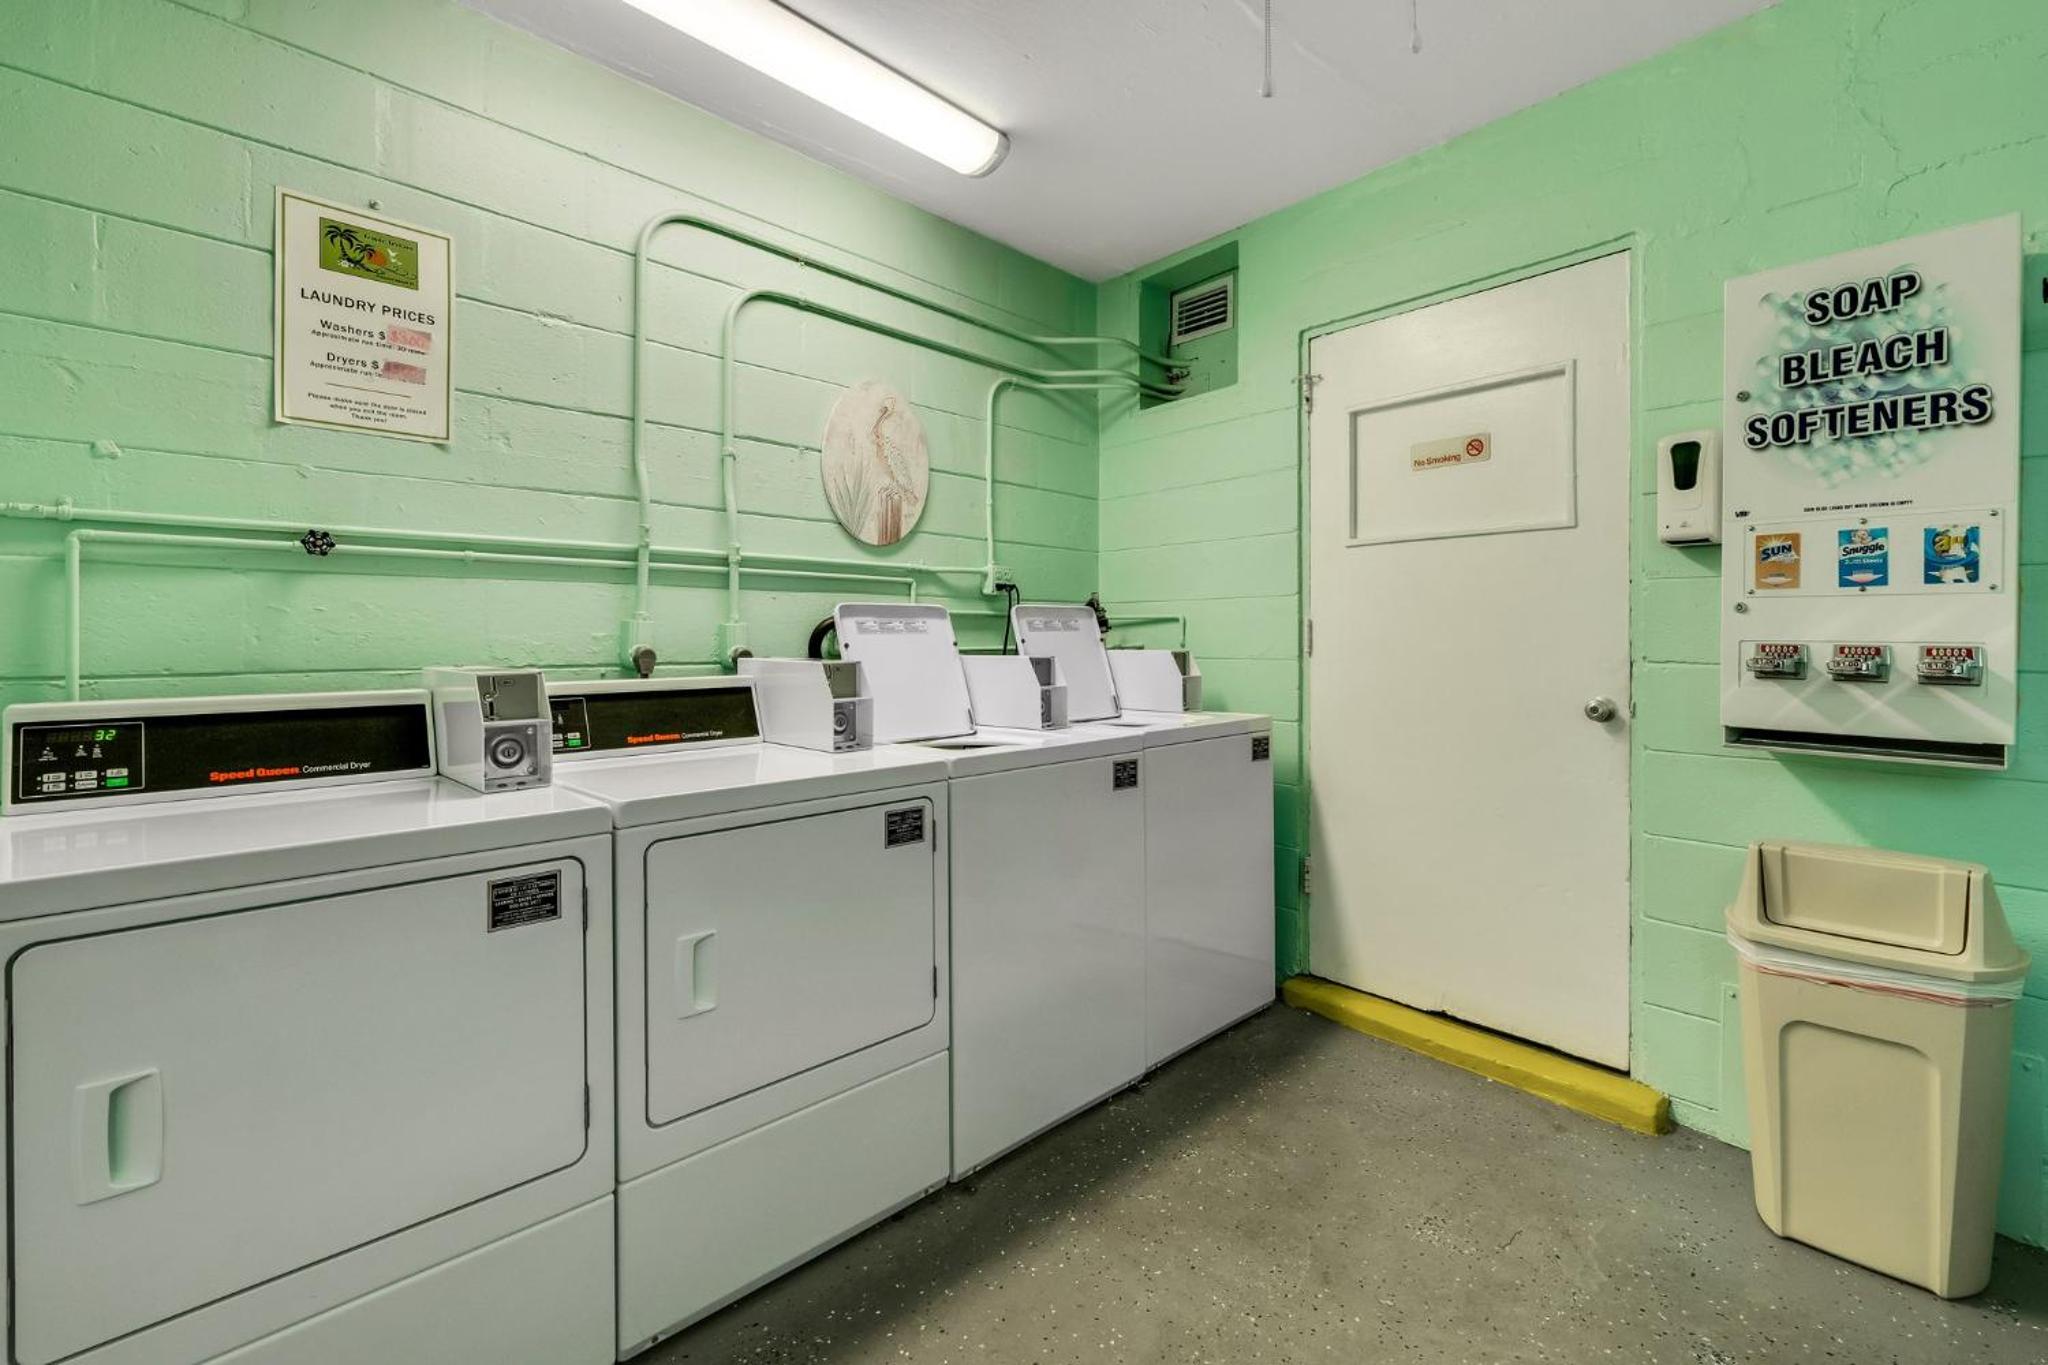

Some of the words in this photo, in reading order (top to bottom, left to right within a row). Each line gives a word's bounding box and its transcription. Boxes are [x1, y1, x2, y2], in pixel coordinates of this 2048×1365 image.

[301, 287, 376, 313] LAUNDRY
[381, 305, 435, 326] PRICES
[1805, 272, 1920, 325] SOAP
[320, 319, 374, 338] Washers
[327, 352, 367, 368] Dryers
[1782, 329, 1947, 387] BLEACH
[1746, 386, 1992, 448] SOFTENERS
[1426, 454, 1461, 465] Smoking
[1761, 544, 1792, 561] SUN
[1842, 543, 1885, 557] Snuggle
[96, 729, 116, 741] 32
[210, 769, 254, 782] Speed
[256, 766, 299, 777] Queen
[302, 762, 349, 774] Commercial
[351, 761, 371, 771] Dryer
